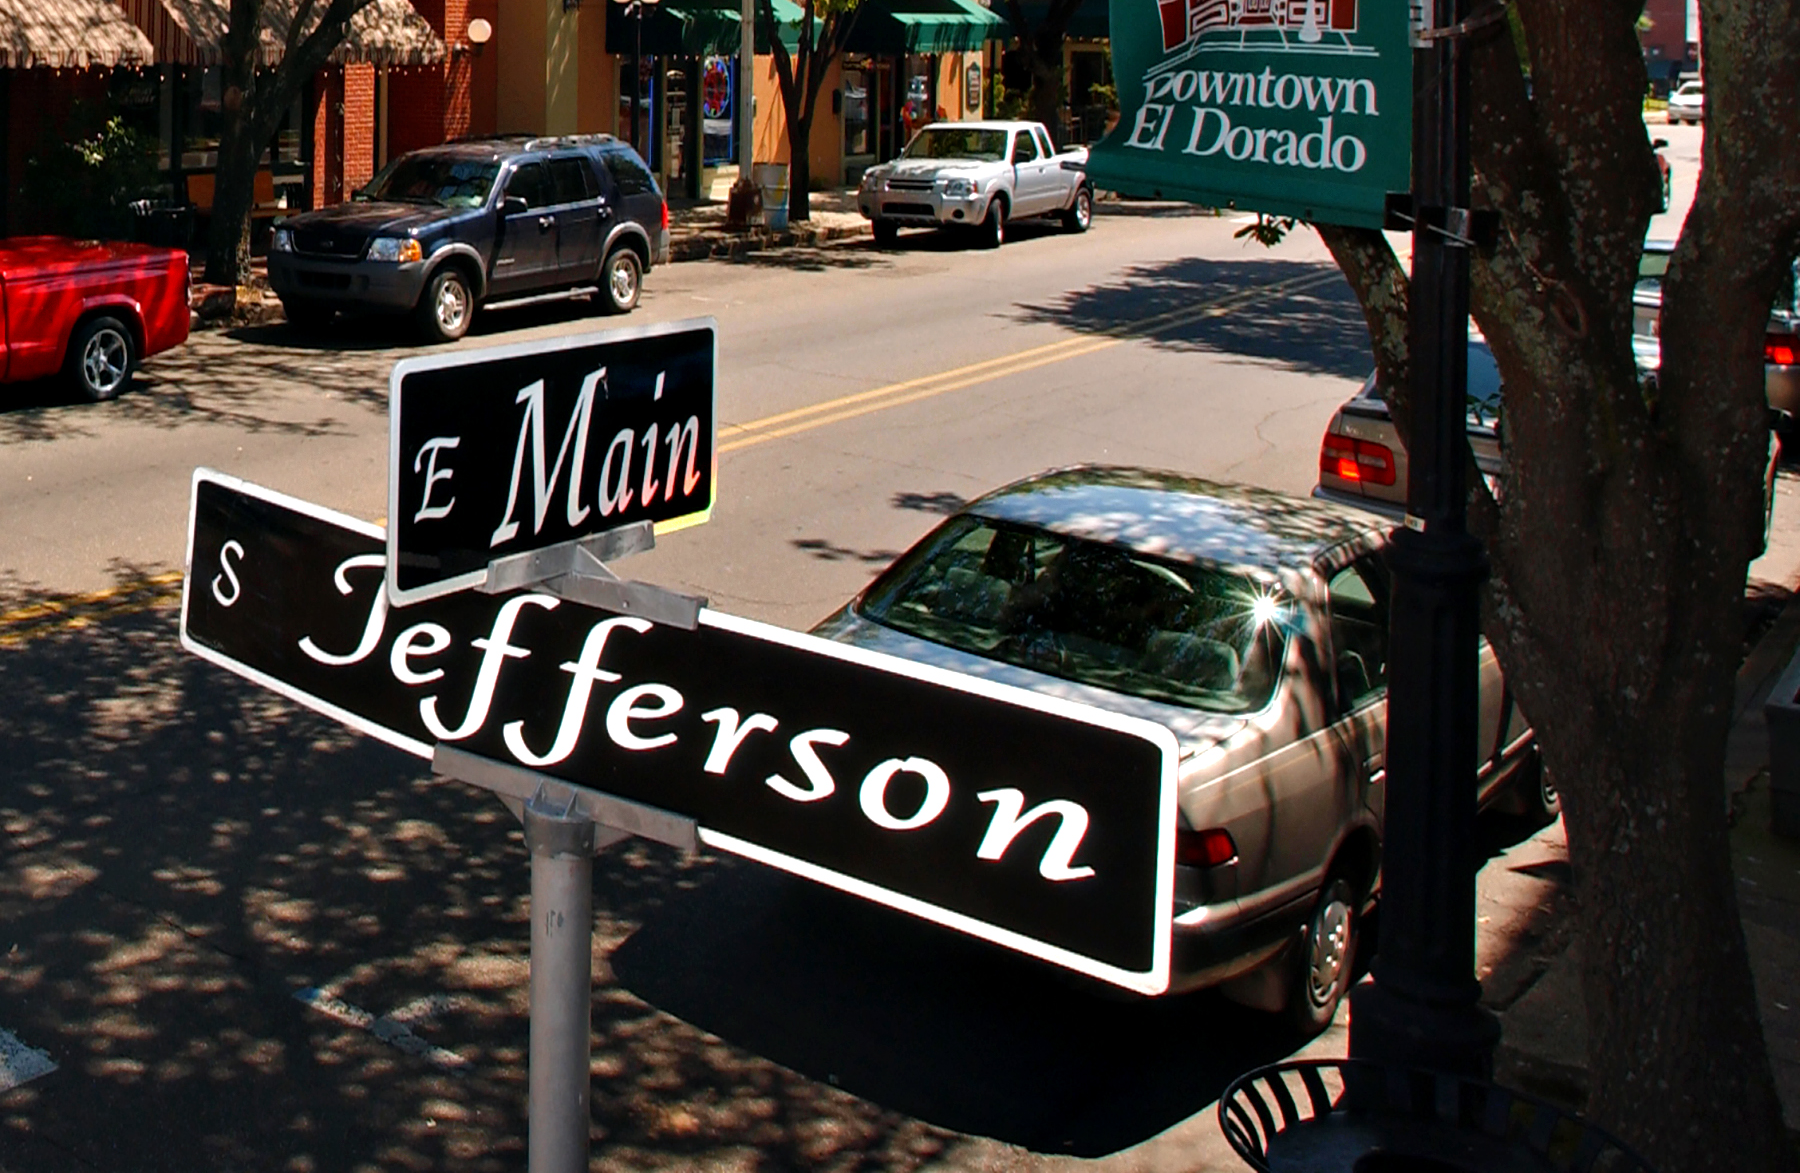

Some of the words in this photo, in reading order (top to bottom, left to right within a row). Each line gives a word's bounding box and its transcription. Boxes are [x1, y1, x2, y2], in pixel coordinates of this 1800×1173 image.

[1123, 103, 1176, 150] El
[1181, 106, 1367, 173] Dorado
[1143, 65, 1380, 116] Downtown
[413, 436, 461, 524] E
[489, 366, 701, 549] Main
[211, 539, 243, 607] S
[298, 553, 1096, 882] Jefferson
